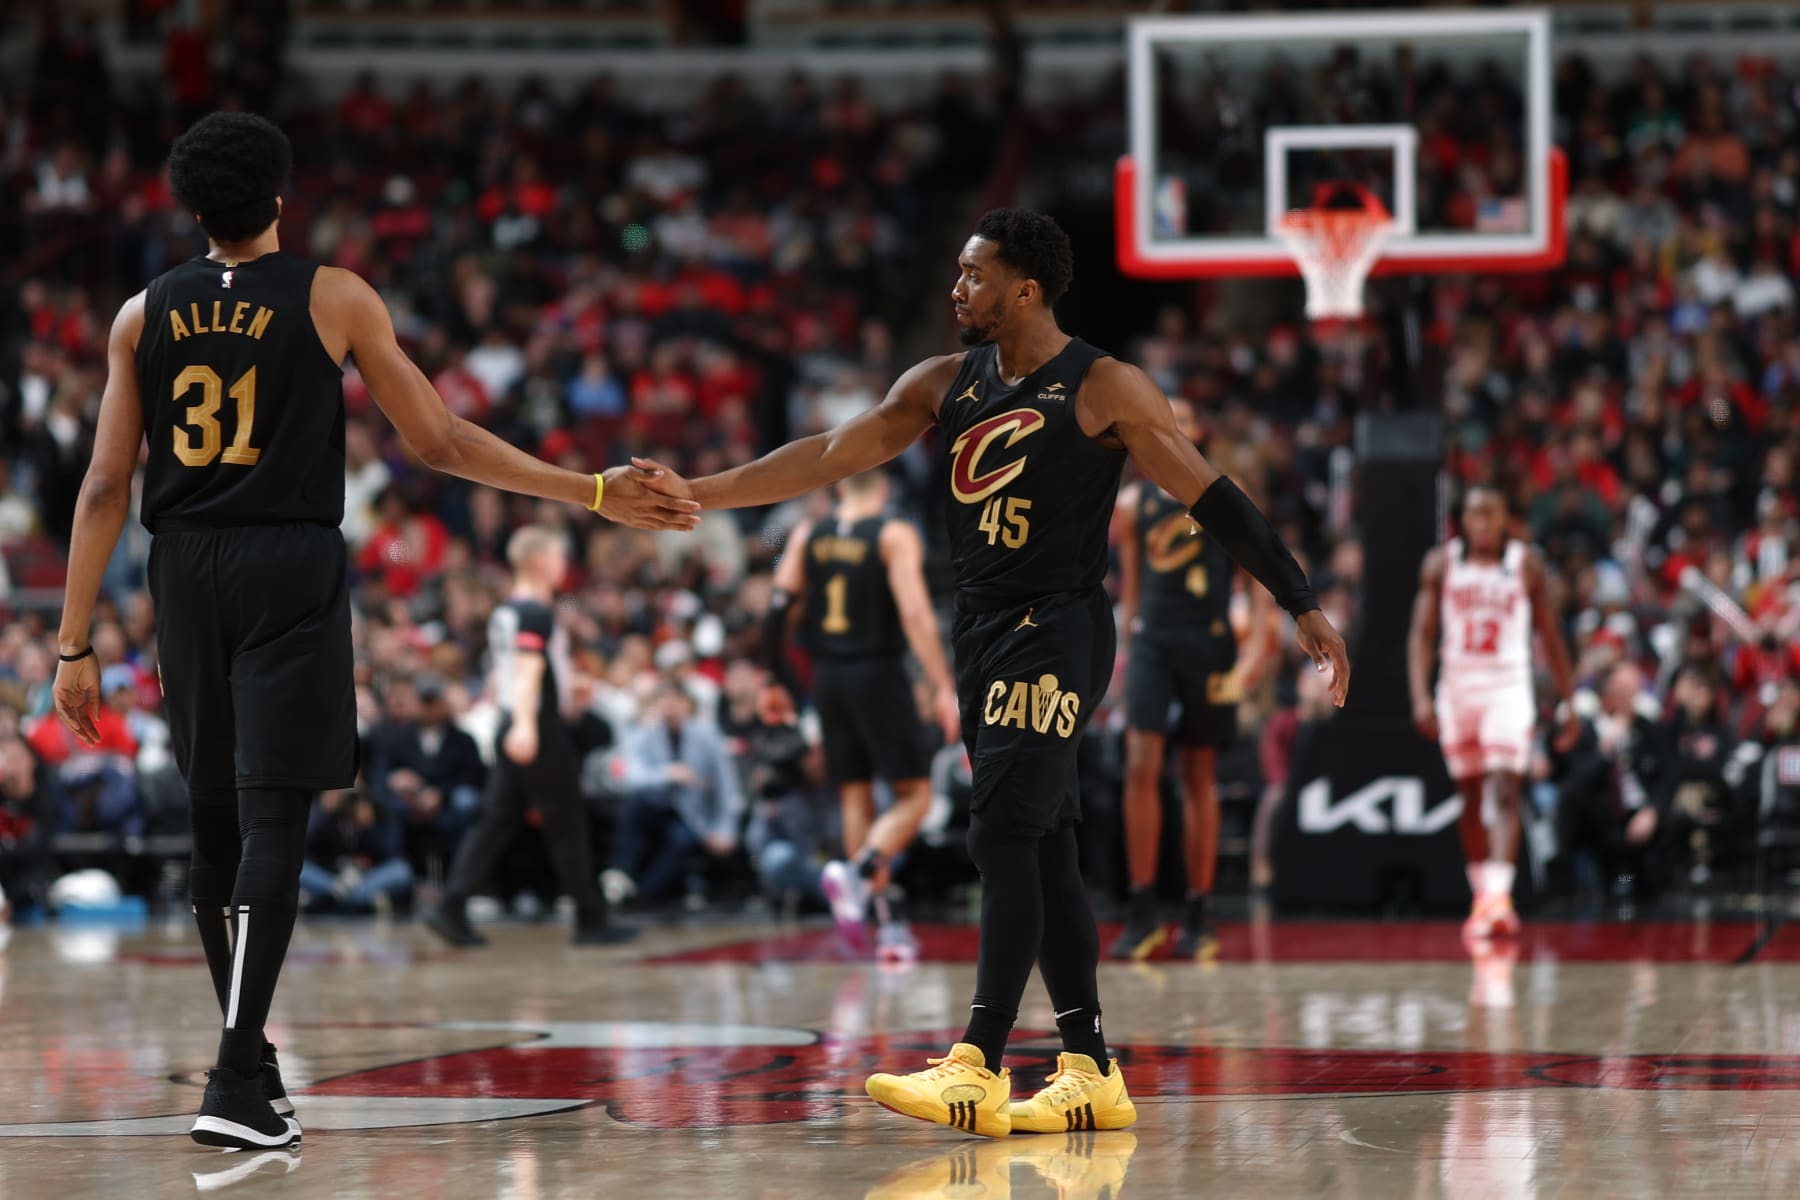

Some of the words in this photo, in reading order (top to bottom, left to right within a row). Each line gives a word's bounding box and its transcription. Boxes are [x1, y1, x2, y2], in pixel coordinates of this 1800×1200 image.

[169, 301, 275, 341] ALLEN
[172, 364, 262, 466] 31
[1037, 393, 1066, 401] CLIFFS
[950, 407, 1046, 505] C
[978, 496, 1033, 549] 45
[823, 574, 850, 634] 1
[1463, 620, 1500, 655] 12
[984, 674, 1080, 739] CAVS
